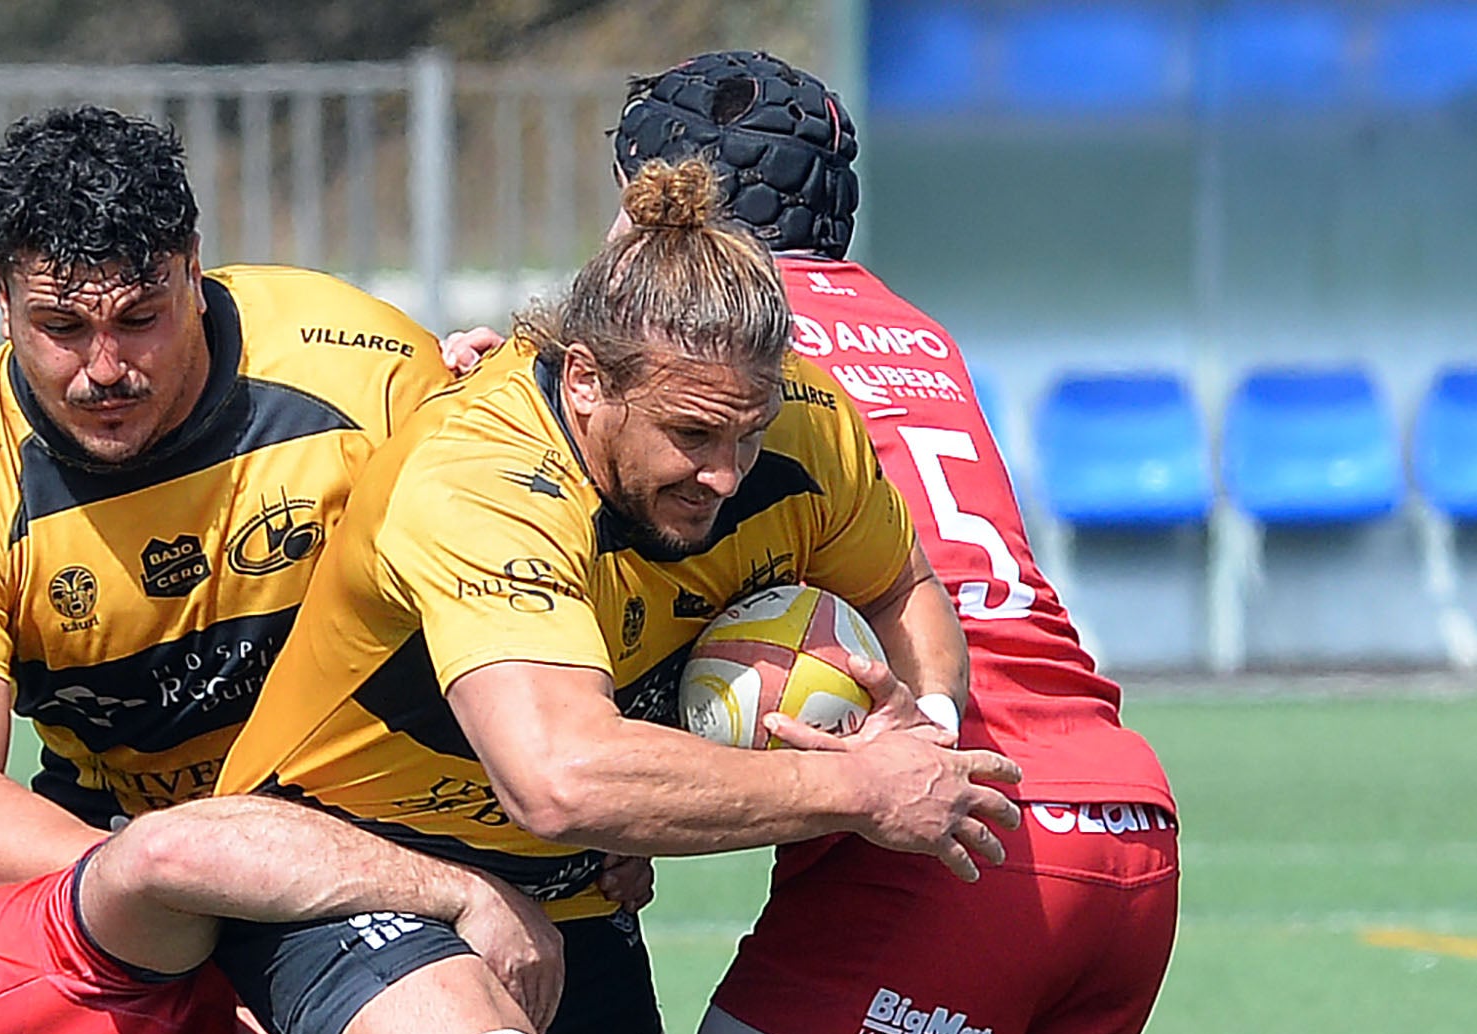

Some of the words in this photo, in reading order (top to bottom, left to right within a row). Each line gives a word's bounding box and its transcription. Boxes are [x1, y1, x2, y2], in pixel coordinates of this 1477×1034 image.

[300, 327, 415, 358] VILLARCE
[835, 321, 950, 359] AMPO
[897, 425, 1036, 620] 5
[149, 543, 194, 566] BAJO
[156, 563, 205, 588] CERO
